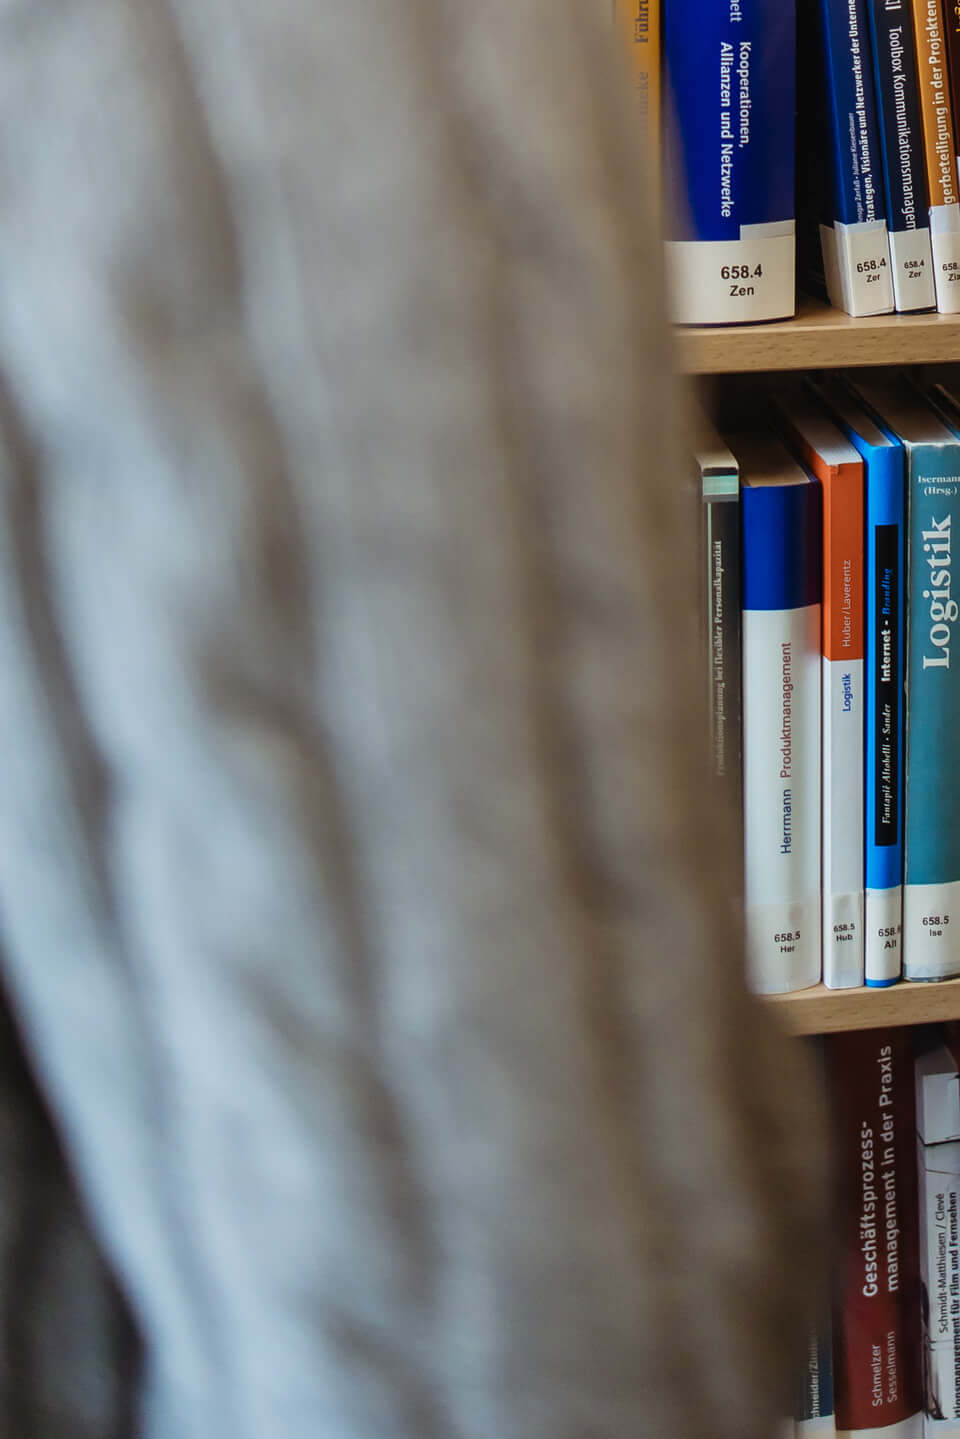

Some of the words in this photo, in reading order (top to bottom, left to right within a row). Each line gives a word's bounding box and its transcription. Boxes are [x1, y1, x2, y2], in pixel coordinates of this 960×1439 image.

[850, 36, 861, 55] der
[720, 41, 734, 108] Allianzen
[854, 56, 867, 108] Netzwerker
[929, 65, 943, 88] der
[736, 41, 752, 148] Kooperationen,
[931, 89, 944, 105] in
[720, 111, 734, 140] und
[858, 110, 867, 128] und
[860, 128, 872, 174] Visionäre
[720, 143, 734, 218] Netzwerke
[862, 174, 876, 223] Strategen,
[720, 264, 763, 280] 658.4
[856, 257, 887, 273] 658.4
[866, 273, 881, 284] Zer
[903, 259, 925, 270] 658.4
[729, 285, 755, 297] Zen
[923, 486, 958, 497] (Hrsg.)
[881, 567, 893, 615] Branding
[922, 514, 959, 670] Logistik
[881, 629, 892, 682] Internet
[842, 672, 854, 712] Logistik
[780, 642, 794, 778] Produktmanagement
[882, 703, 892, 735] Sander
[882, 744, 892, 782] Altobelli
[781, 789, 792, 854] Herrmann
[774, 930, 801, 943] 658.5
[833, 922, 855, 933] 658.5
[922, 915, 950, 926] 658.5
[929, 928, 943, 937] Ise
[879, 1045, 893, 1107] Praxis
[881, 1113, 895, 1142] der
[883, 1150, 896, 1167] in
[860, 1121, 878, 1297] Geschäftsprozess-
[949, 1192, 957, 1247] Fernsehen
[885, 1171, 900, 1293] management
[950, 1248, 959, 1264] und
[951, 1266, 960, 1298] Film
[951, 1300, 960, 1320] für
[887, 1331, 896, 1403] Sesselmann
